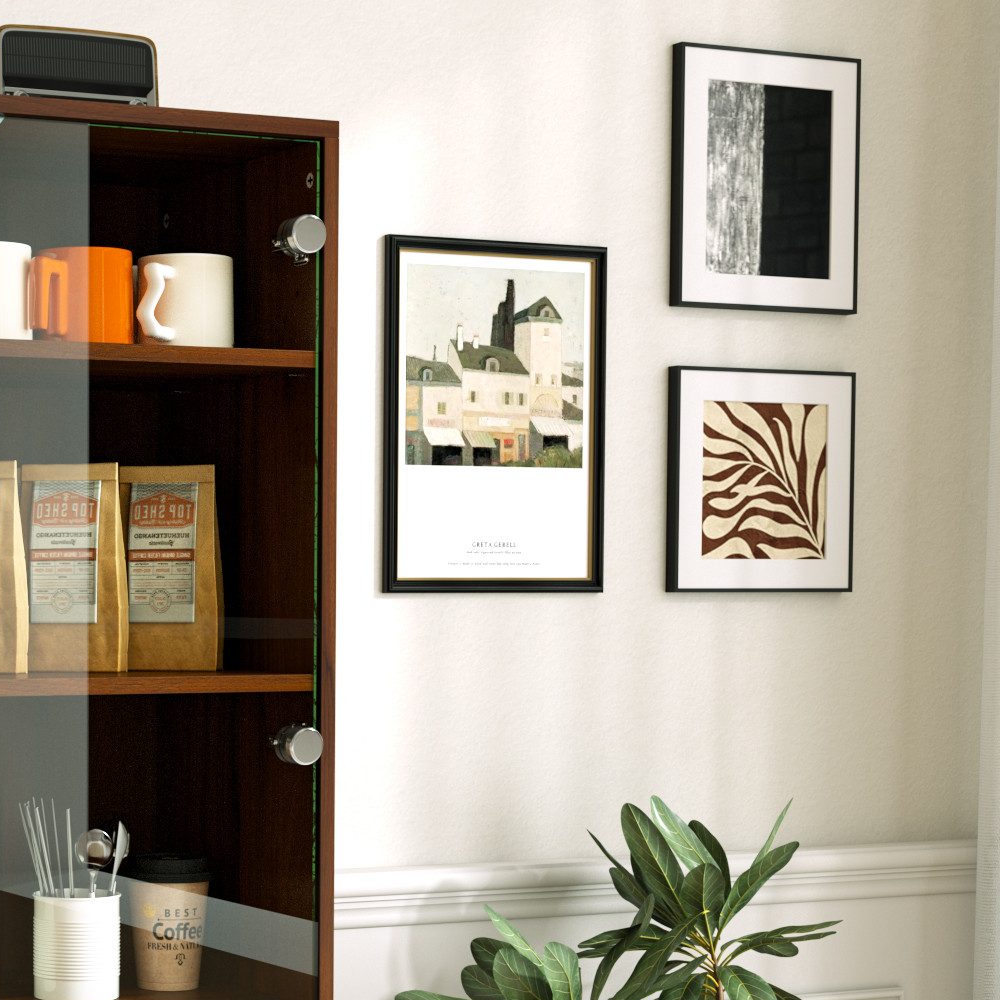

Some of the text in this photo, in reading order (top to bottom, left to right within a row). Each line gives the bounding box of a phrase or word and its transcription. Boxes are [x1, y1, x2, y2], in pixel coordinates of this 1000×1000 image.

[164, 907, 198, 917] BEST
[152, 922, 203, 941] Coffee
[147, 942, 172, 950] FRESH
